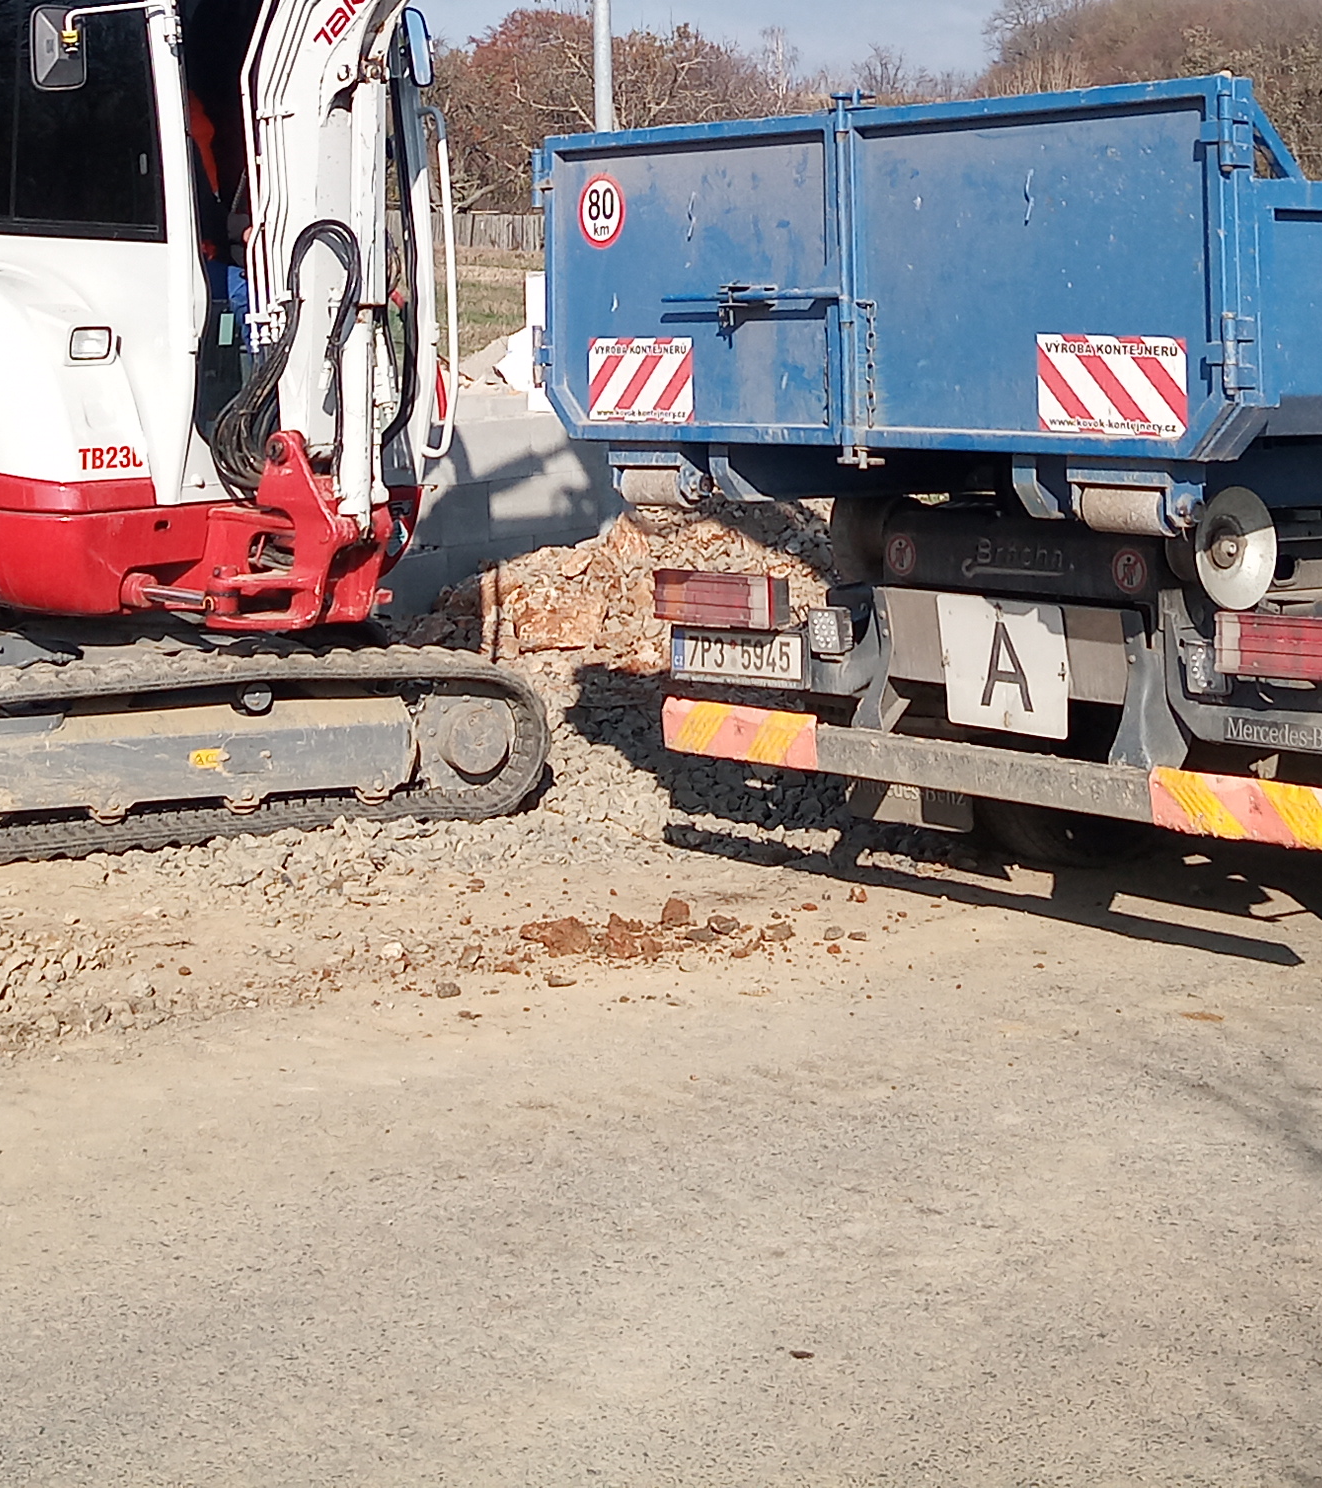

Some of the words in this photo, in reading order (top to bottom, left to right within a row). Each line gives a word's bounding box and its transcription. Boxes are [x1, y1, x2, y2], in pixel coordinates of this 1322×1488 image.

[588, 187, 614, 221] 80
[593, 222, 610, 236] km
[1096, 342, 1179, 357] KONTEJNERŮ
[688, 635, 725, 668] 7P3
[740, 638, 791, 673] 5945
[980, 621, 1034, 713] A
